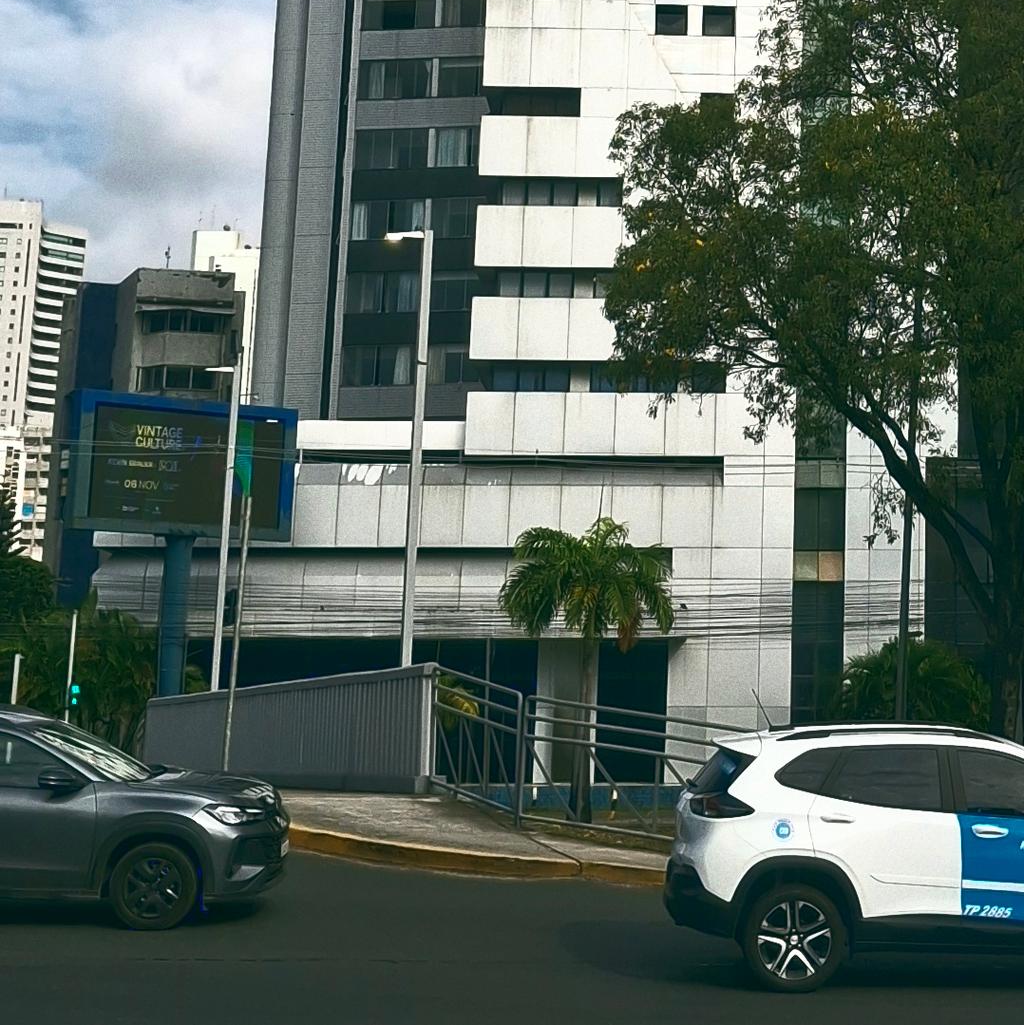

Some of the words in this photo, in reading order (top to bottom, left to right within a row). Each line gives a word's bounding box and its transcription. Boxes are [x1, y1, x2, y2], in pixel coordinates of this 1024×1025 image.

[136, 424, 183, 438] VINTAGE
[135, 437, 183, 451] CULTURE
[138, 480, 160, 490] NOV
[962, 904, 980, 916] TP
[980, 905, 1013, 918] 2885
